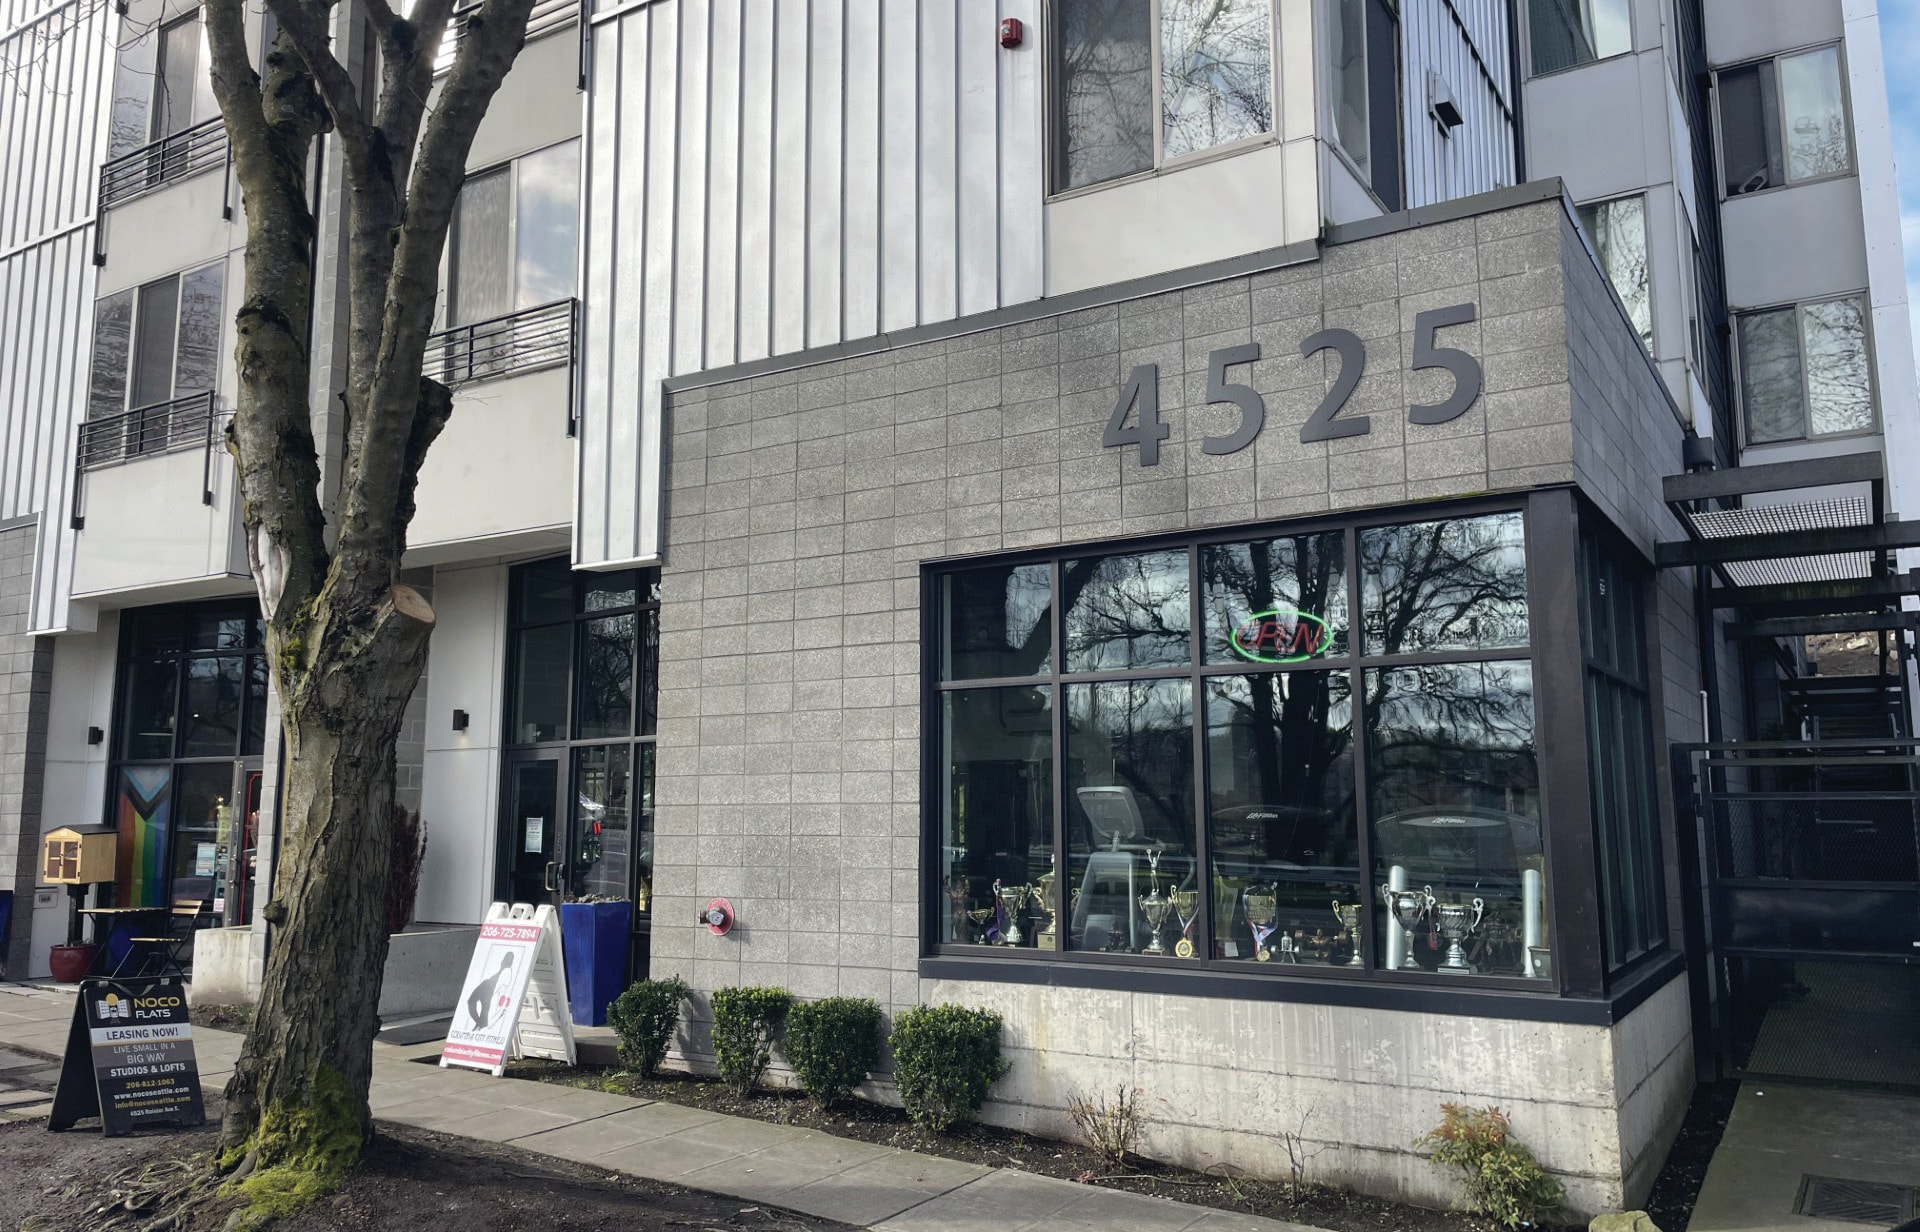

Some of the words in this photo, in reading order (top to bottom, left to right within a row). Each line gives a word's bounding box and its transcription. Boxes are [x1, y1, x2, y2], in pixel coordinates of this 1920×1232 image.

[1103, 302, 1482, 467] 4525
[482, 926, 537, 939] 206-725-7894
[133, 996, 181, 1008] NOCO
[135, 1009, 171, 1019] FLATS
[106, 1029, 149, 1040] LEASING
[152, 1027, 179, 1037] NOW!
[113, 1046, 131, 1054] LIVE
[133, 1044, 159, 1052] SMALL
[126, 1055, 144, 1064] BIG
[146, 1053, 166, 1062] WAY
[110, 1065, 149, 1077] STUDIOS
[151, 1065, 158, 1073] &
[160, 1063, 186, 1073] LOFTS
[113, 1086, 189, 1100] www.nocoseattle.com
[115, 1096, 191, 1109] info@nocoseattle.com
